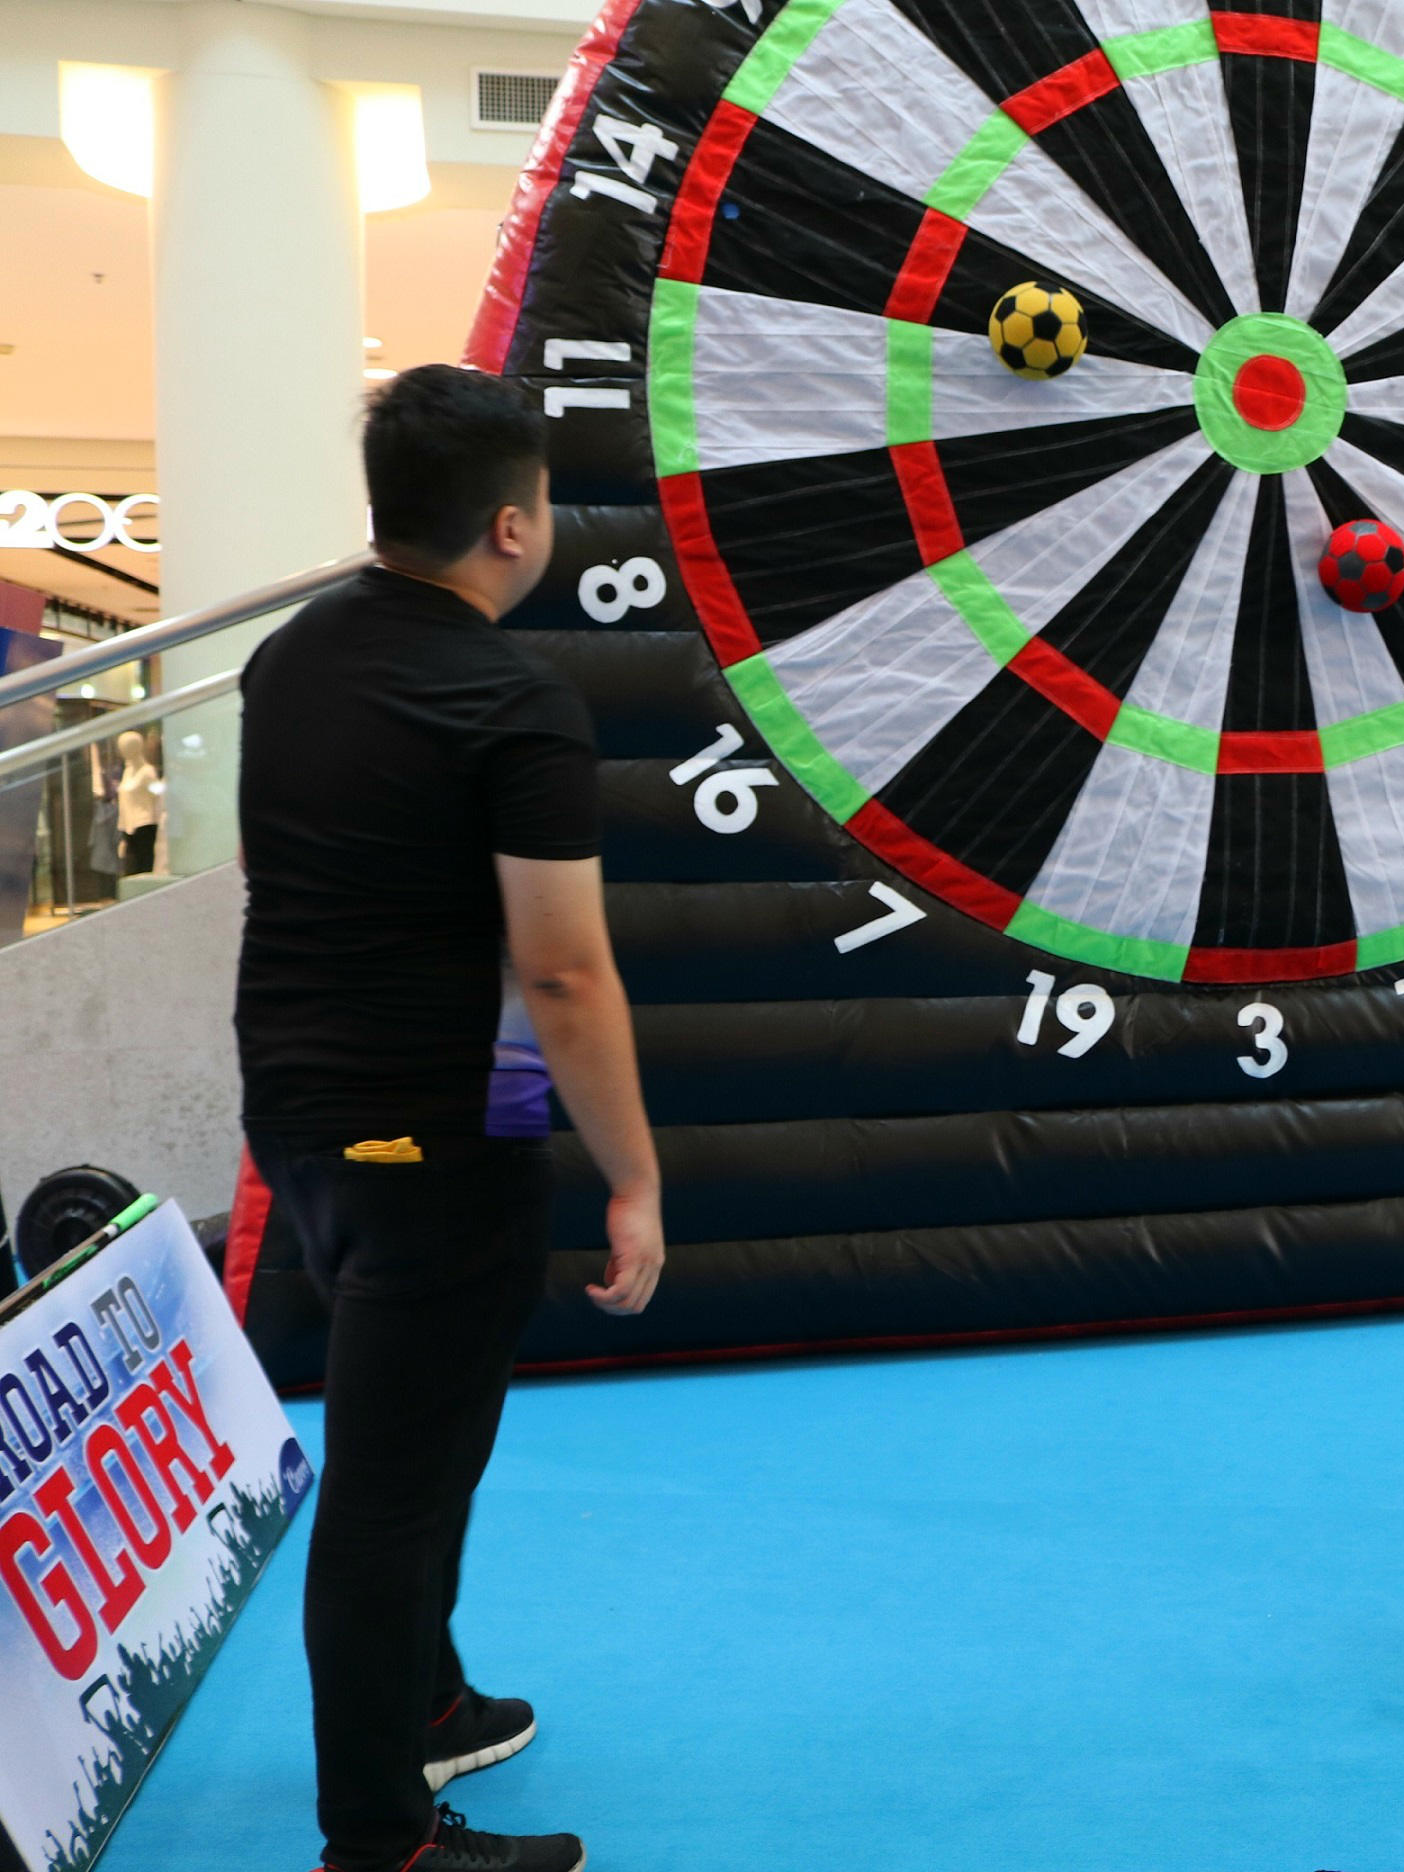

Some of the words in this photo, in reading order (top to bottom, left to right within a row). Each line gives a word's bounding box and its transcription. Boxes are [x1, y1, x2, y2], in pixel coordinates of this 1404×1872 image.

[569, 113, 679, 214] 14
[543, 338, 631, 418] 11
[578, 556, 666, 623] 8
[669, 723, 780, 834] 16
[833, 881, 927, 954] 7
[1017, 970, 1115, 1059] 19
[1237, 1002, 1289, 1078] 3
[91, 1276, 161, 1371] TO
[0, 1339, 235, 1681] GLORY
